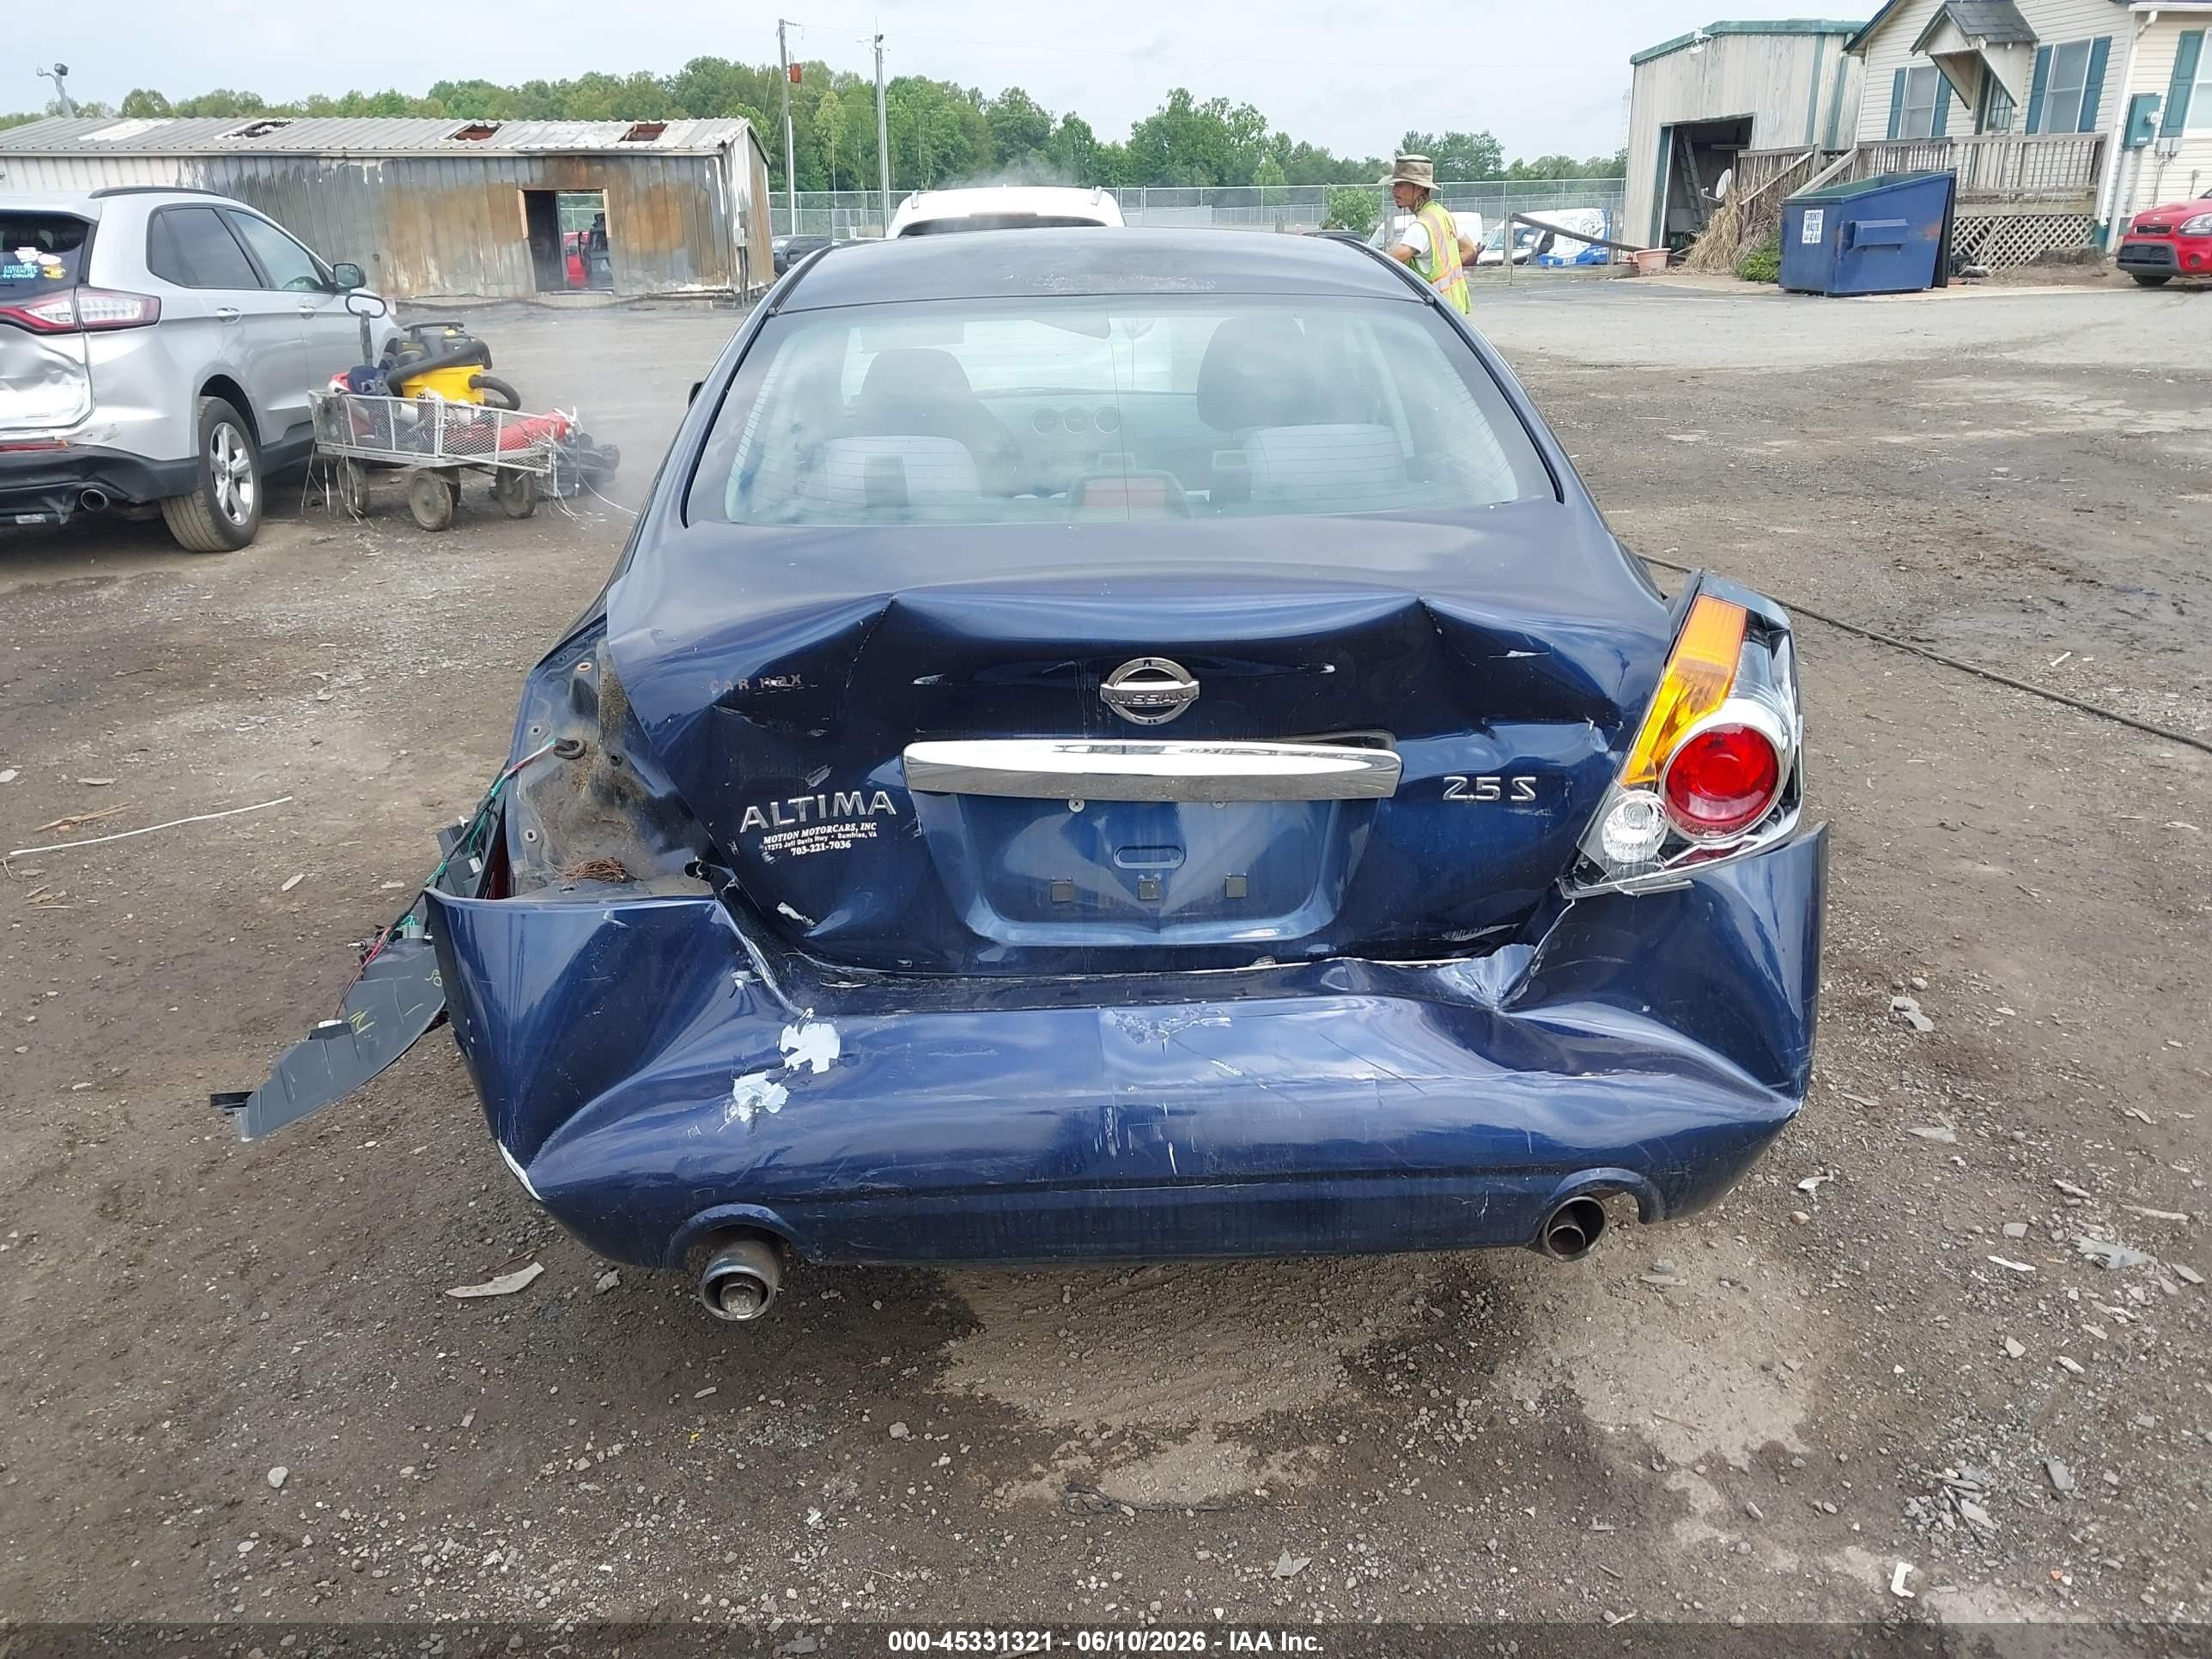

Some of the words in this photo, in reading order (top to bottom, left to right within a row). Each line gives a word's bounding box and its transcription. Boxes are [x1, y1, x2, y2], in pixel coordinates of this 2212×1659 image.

[1110, 693, 1190, 706] NISSAN
[1510, 776, 1536, 802] S
[739, 791, 897, 834] ALTIMA
[763, 830, 799, 845] MOTION
[800, 823, 859, 838] MOTORCARS,
[860, 822, 878, 831] INC
[797, 836, 813, 846] Davis
[790, 839, 852, 857] 703-221-7036
